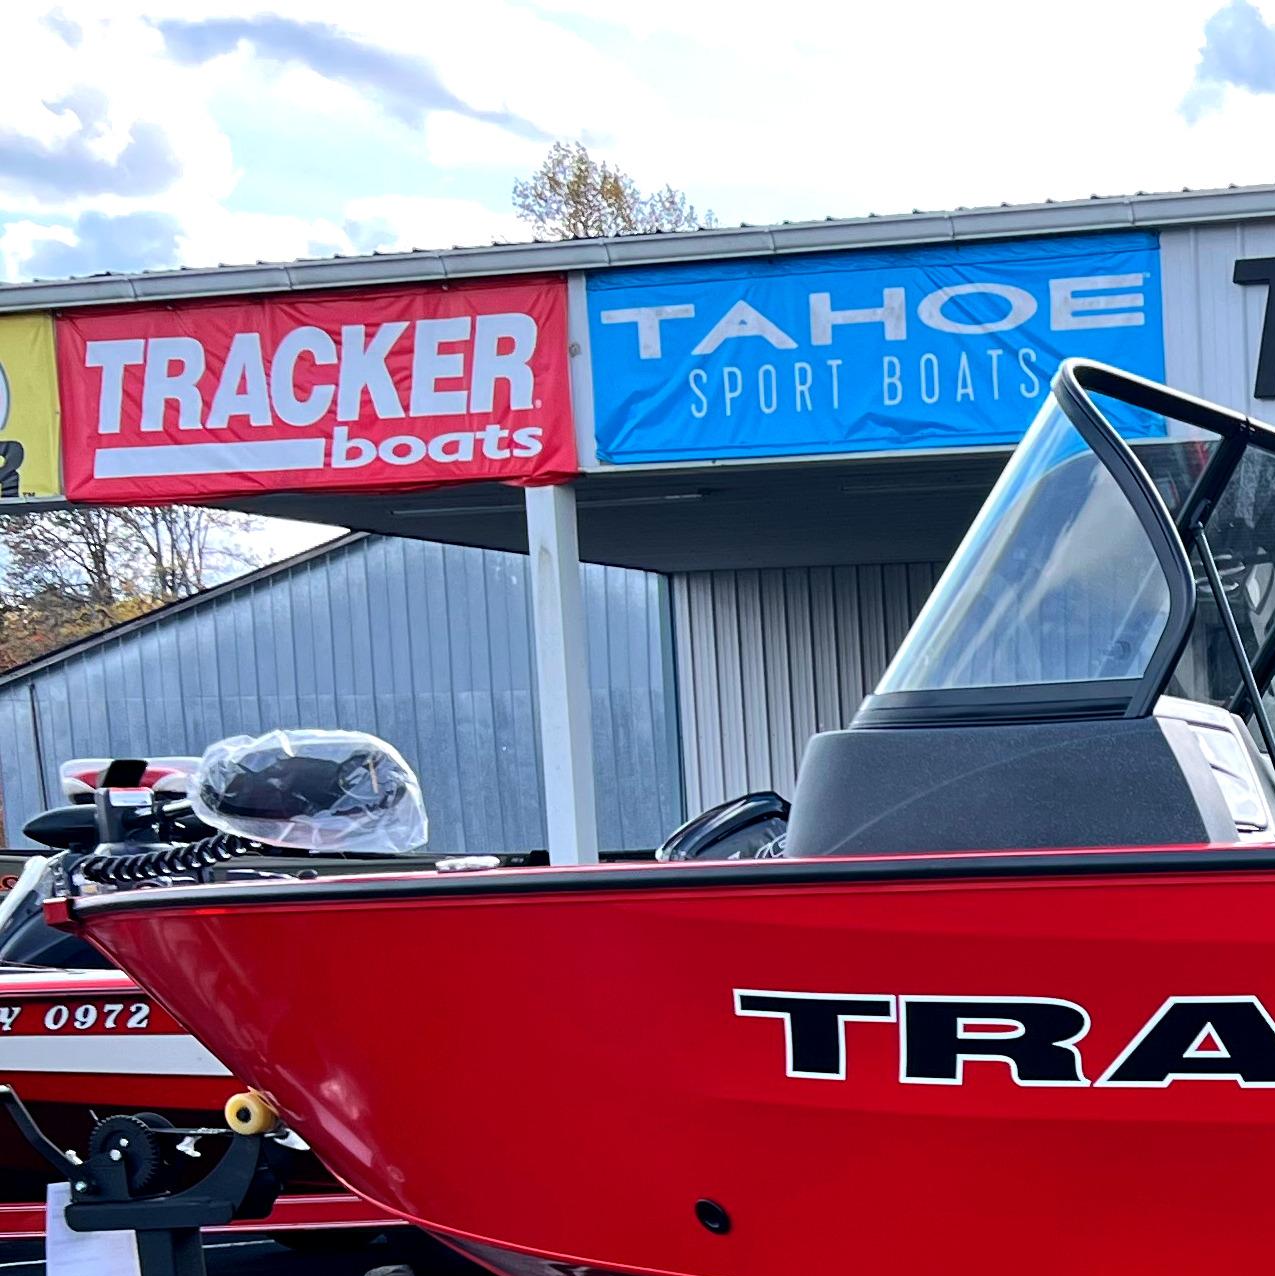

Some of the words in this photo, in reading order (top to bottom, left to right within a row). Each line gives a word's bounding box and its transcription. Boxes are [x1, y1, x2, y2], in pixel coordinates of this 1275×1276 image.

[601, 274, 1145, 359] TAHOE
[86, 312, 538, 434] TRACKER
[690, 359, 842, 418] SPORT
[883, 348, 1041, 407] BOATS
[331, 426, 543, 468] boats
[44, 1003, 151, 1030] 0972
